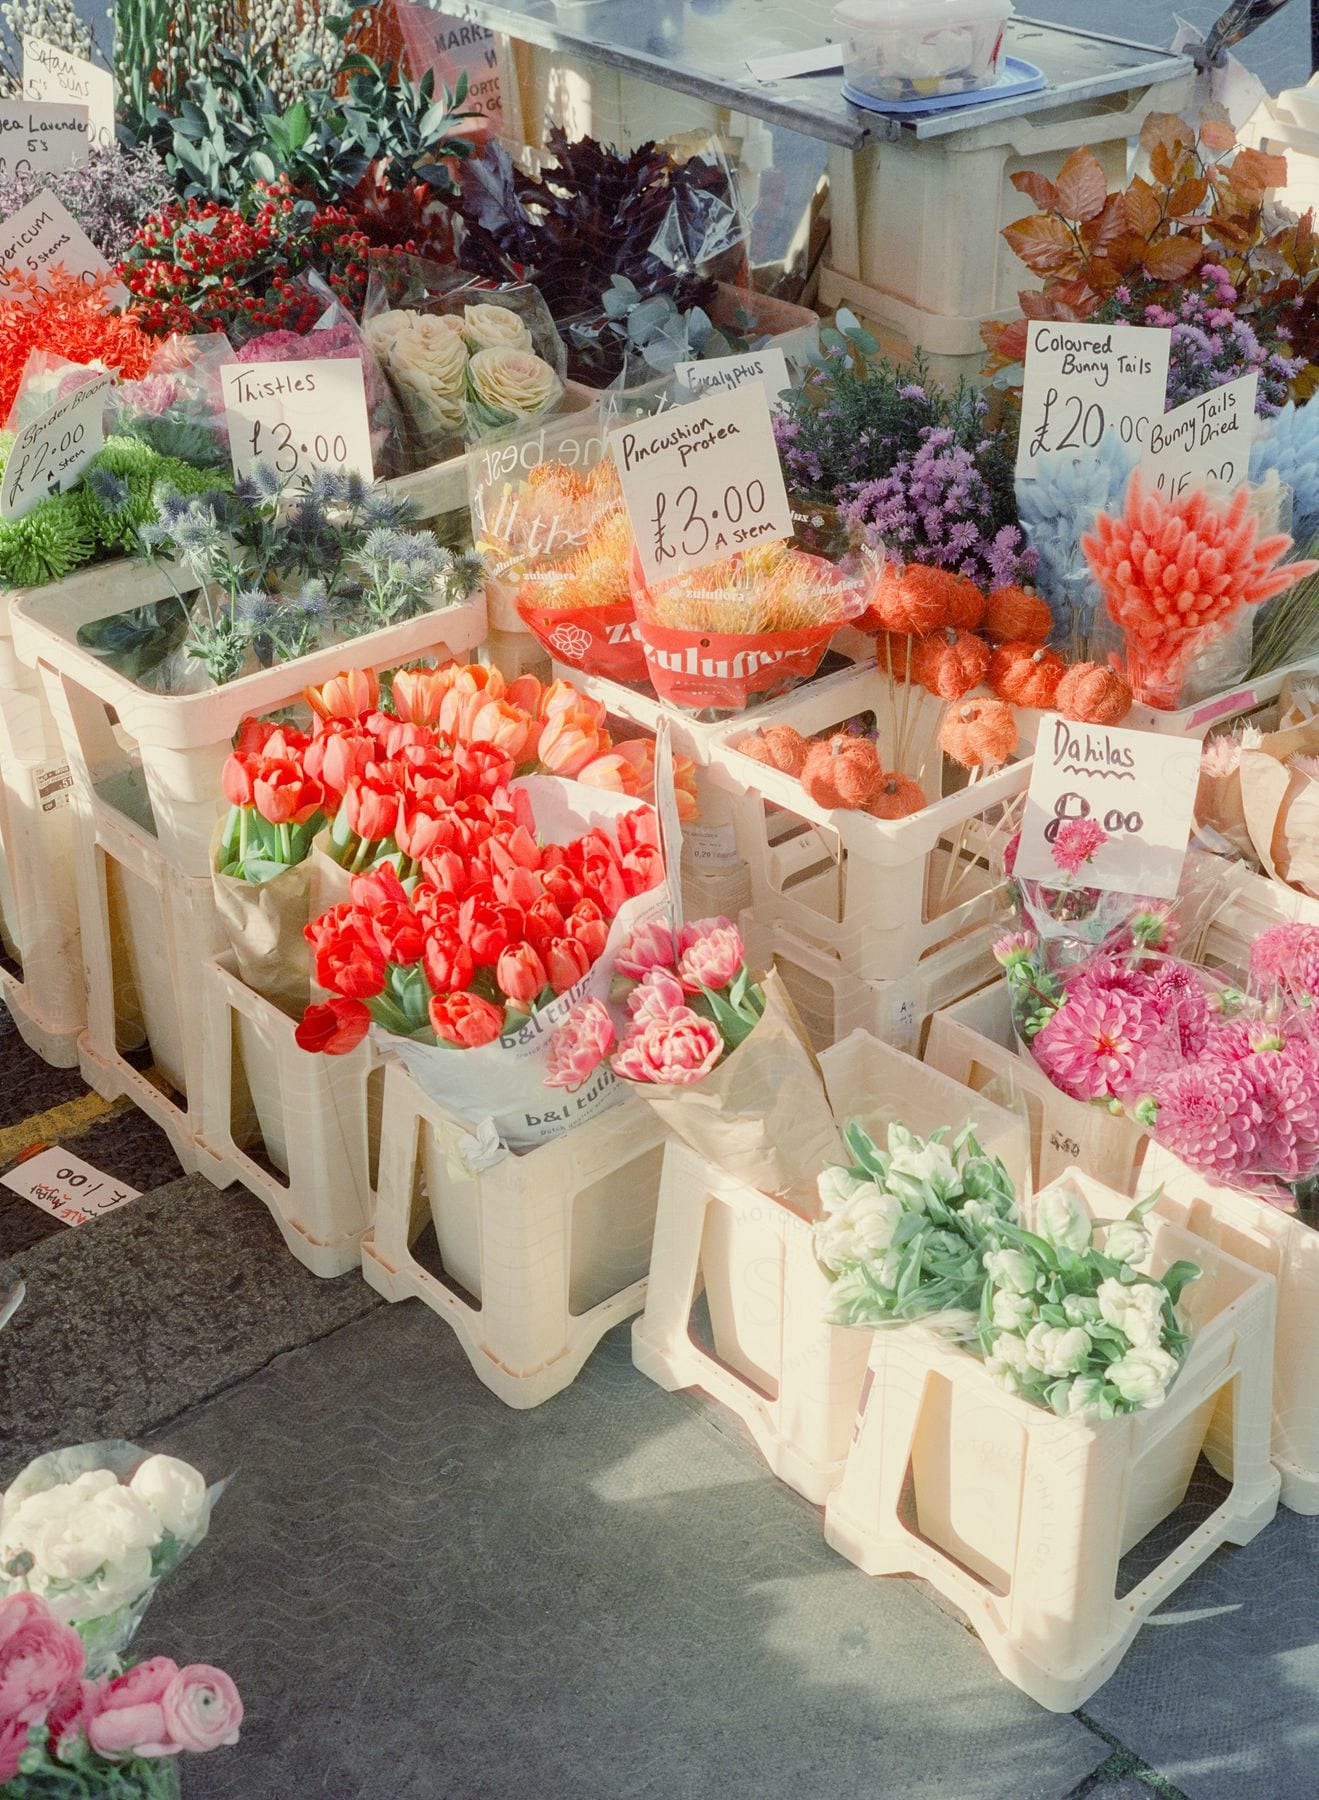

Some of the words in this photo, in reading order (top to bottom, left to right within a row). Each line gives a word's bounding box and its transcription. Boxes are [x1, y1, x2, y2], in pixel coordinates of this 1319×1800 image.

[29, 114, 88, 133] Lavender
[26, 256, 39, 271] 5
[38, 234, 71, 263] stems
[1034, 327, 1112, 353] Coloured
[231, 369, 316, 403] Thistles
[1061, 353, 1110, 387] Bunny
[1117, 355, 1152, 374] Tails
[21, 403, 71, 450] Spider
[1150, 417, 1196, 454] Bunny
[1196, 391, 1237, 423] Tails
[1199, 413, 1240, 446] Dried
[58, 448, 86, 471] stem
[248, 419, 348, 473] £3.00
[622, 417, 714, 472] Pincushion
[677, 423, 741, 468] protea
[8, 423, 86, 508] £2.00
[650, 479, 766, 565] £3.00
[714, 532, 728, 550] A
[733, 522, 777, 544] stem
[1053, 719, 1135, 768] Dahilas
[524, 1104, 571, 1127] b&l
